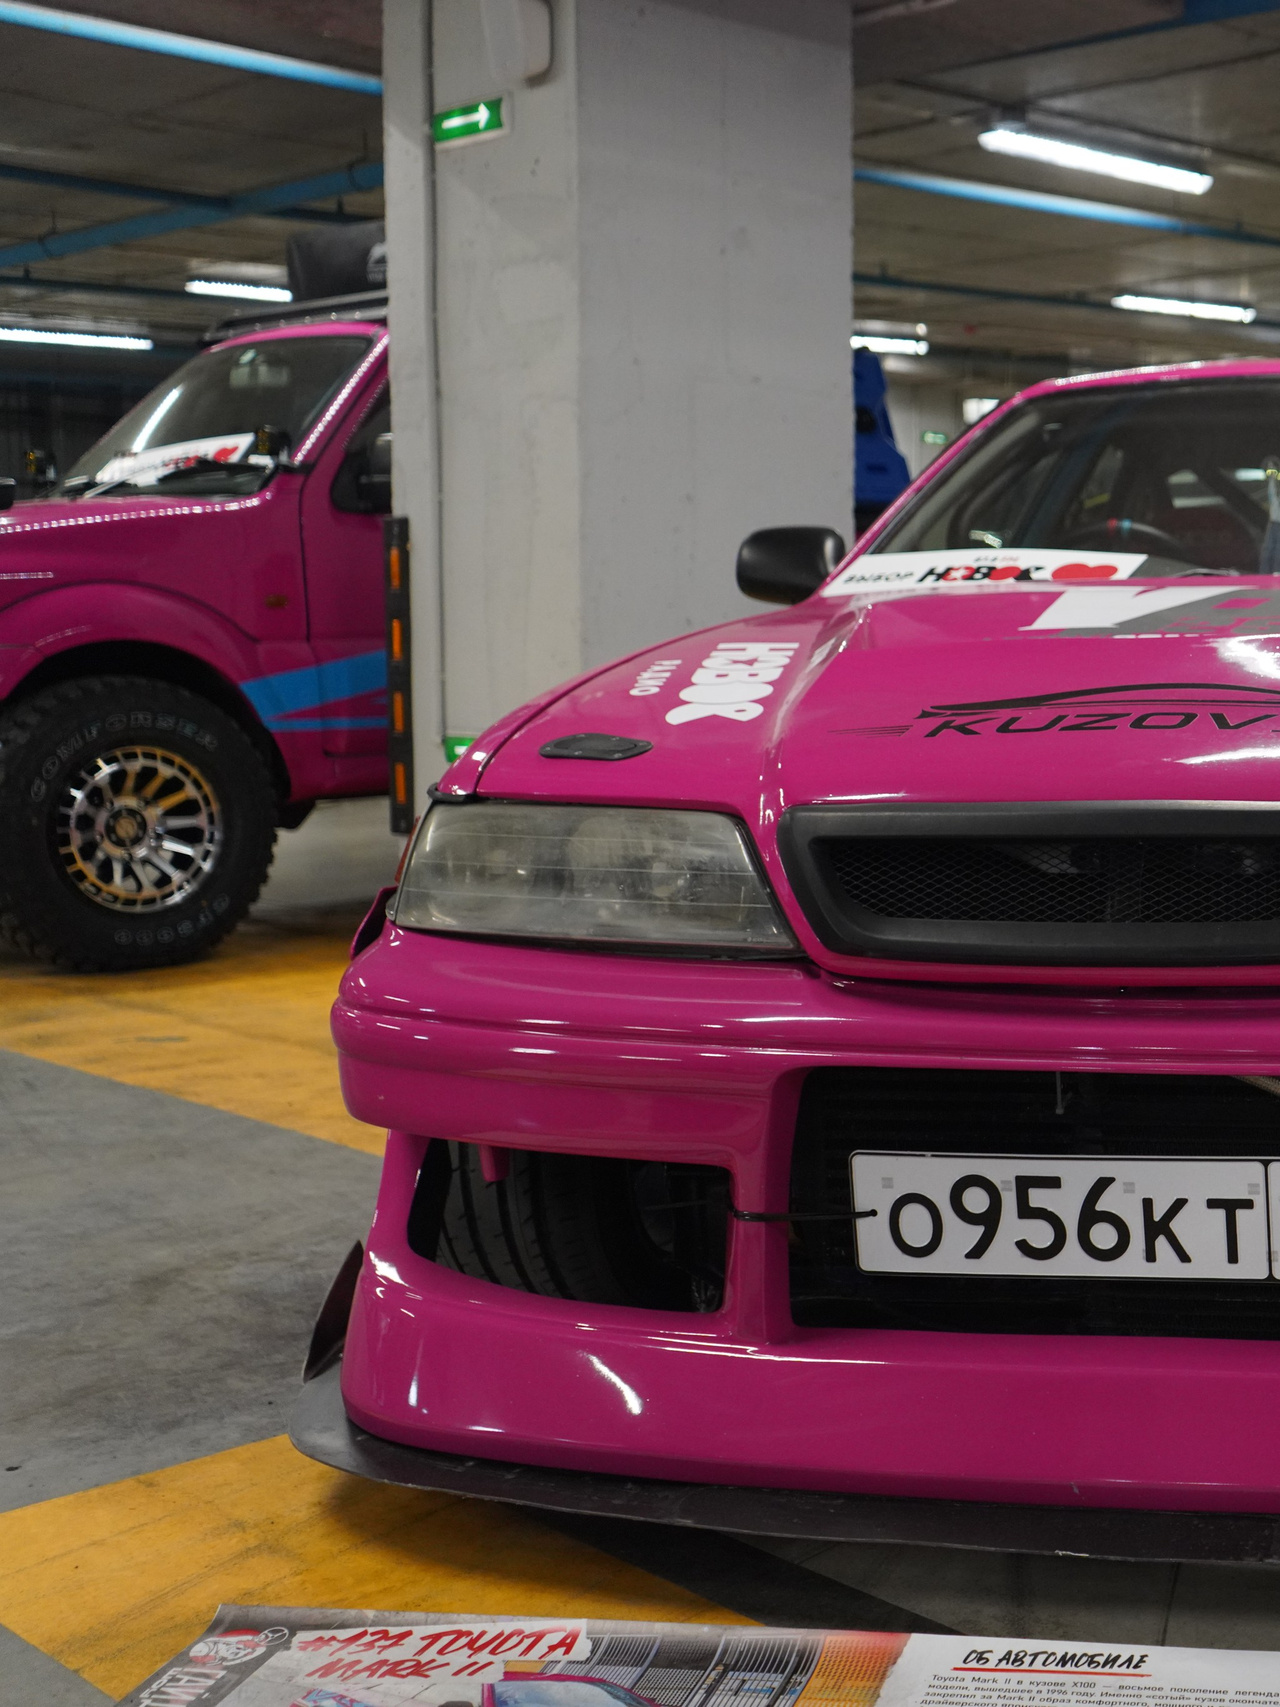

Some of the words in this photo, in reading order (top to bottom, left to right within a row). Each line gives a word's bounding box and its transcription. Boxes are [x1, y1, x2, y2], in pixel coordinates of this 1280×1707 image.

[298, 1629, 413, 1657] #137
[412, 1626, 583, 1660] TOYOTA
[962, 1649, 994, 1666] ОБ
[995, 1650, 1150, 1670] АВТОМОБИЛЕ
[304, 1658, 450, 1682] MARK
[931, 1674, 966, 1684] Toyota
[971, 1676, 998, 1685] Mark
[1029, 1680, 1066, 1688] кузове
[1118, 1684, 1164, 1692] восьмое
[924, 1691, 976, 1699] закрепил
[928, 1684, 970, 1692] модели,
[974, 1686, 1033, 1694] вышедшее
[1046, 1688, 1068, 1696] 1996
[1100, 1691, 1142, 1699] Именно
[1194, 1696, 1225, 1704] кузов
